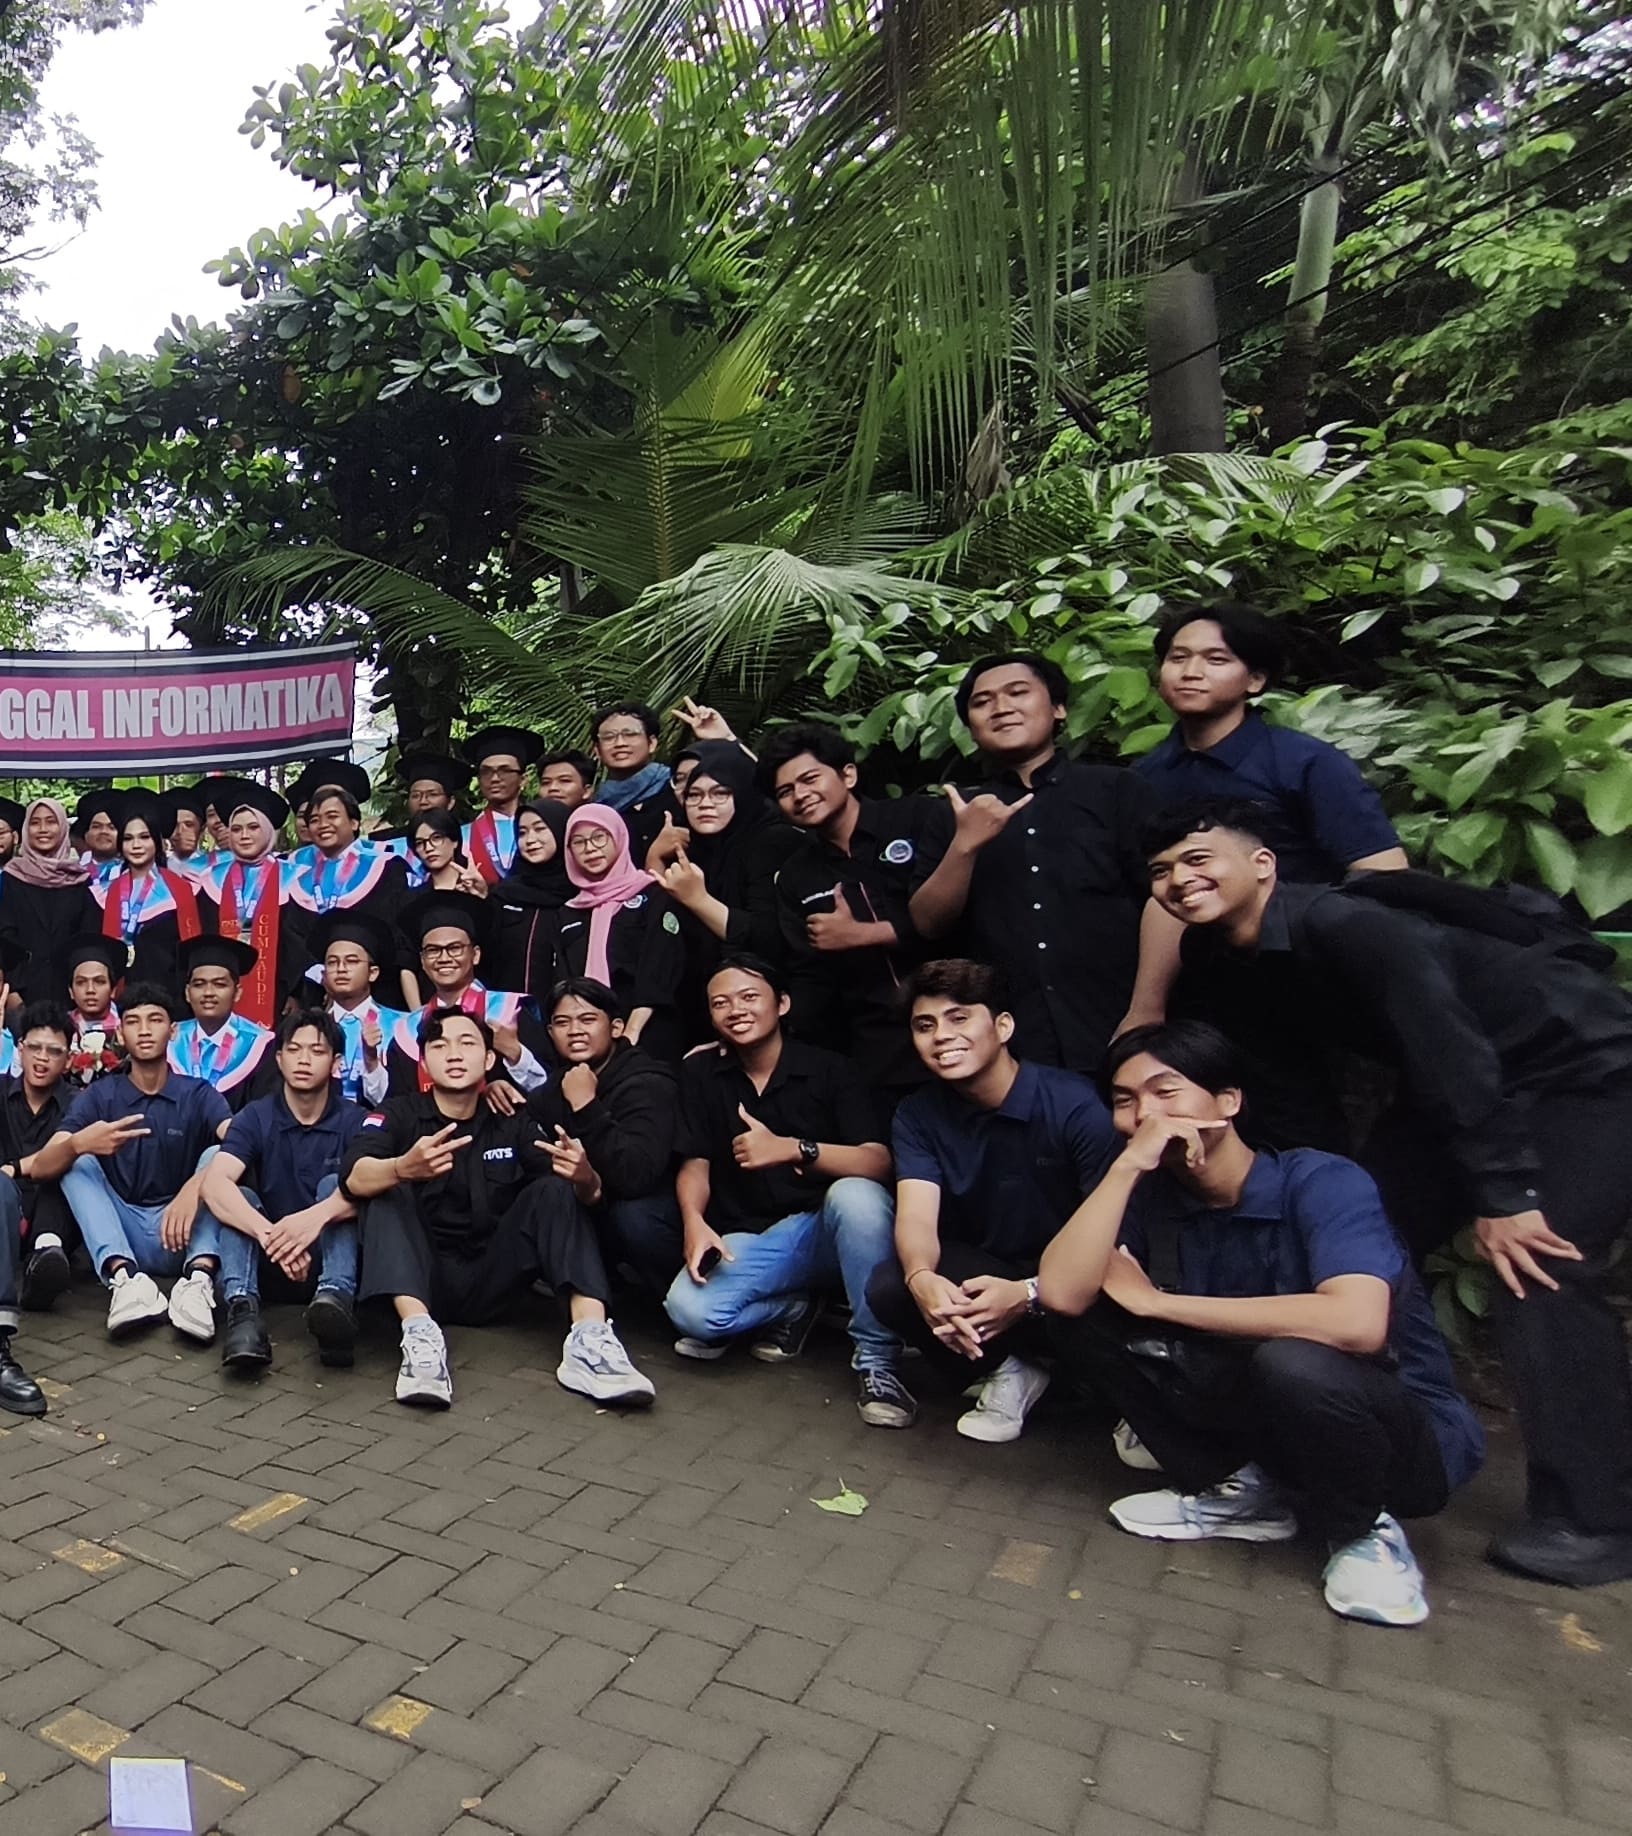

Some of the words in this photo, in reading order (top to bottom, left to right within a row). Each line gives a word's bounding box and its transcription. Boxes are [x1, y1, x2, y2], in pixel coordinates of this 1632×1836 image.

[102, 672, 345, 739] INFORMATIKA
[257, 913, 271, 1006] CUMLAUDE
[483, 1146, 514, 1161] ITATS
